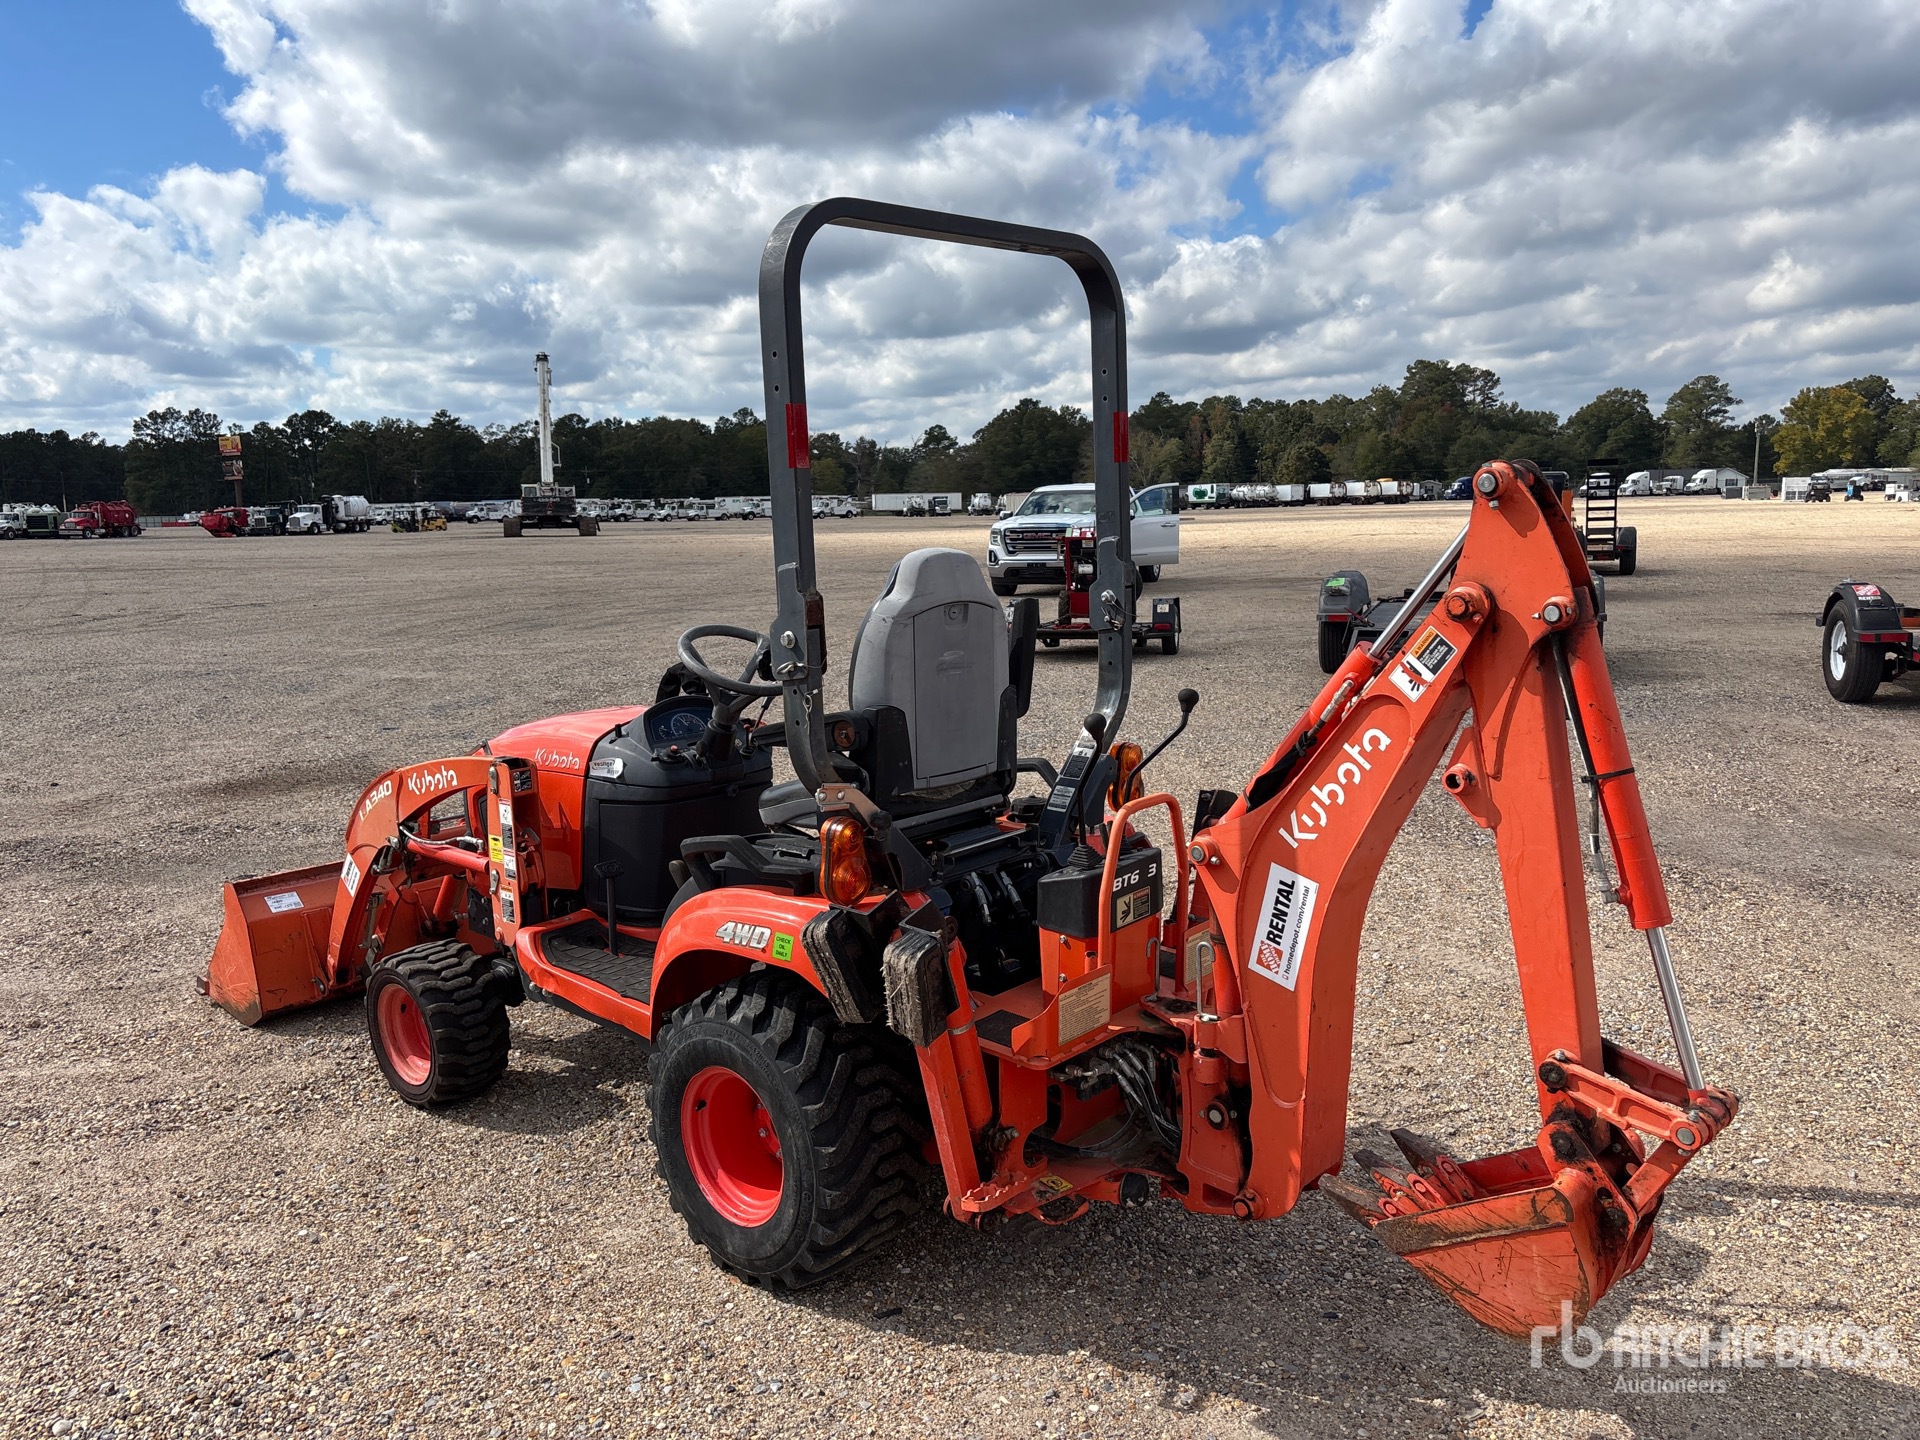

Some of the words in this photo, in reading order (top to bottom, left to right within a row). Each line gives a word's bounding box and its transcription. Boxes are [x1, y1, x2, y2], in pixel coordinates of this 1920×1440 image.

[1418, 632, 1434, 650] WARNING
[535, 748, 580, 770] Kubota
[408, 765, 458, 795] Kubota
[1278, 728, 1392, 849] Kubota
[359, 780, 392, 822] LA340
[1266, 880, 1296, 946] RENTAL
[716, 920, 772, 950] 4WD
[776, 936, 791, 944] CHECK
[1284, 886, 1310, 974] homedepot.com/rental
